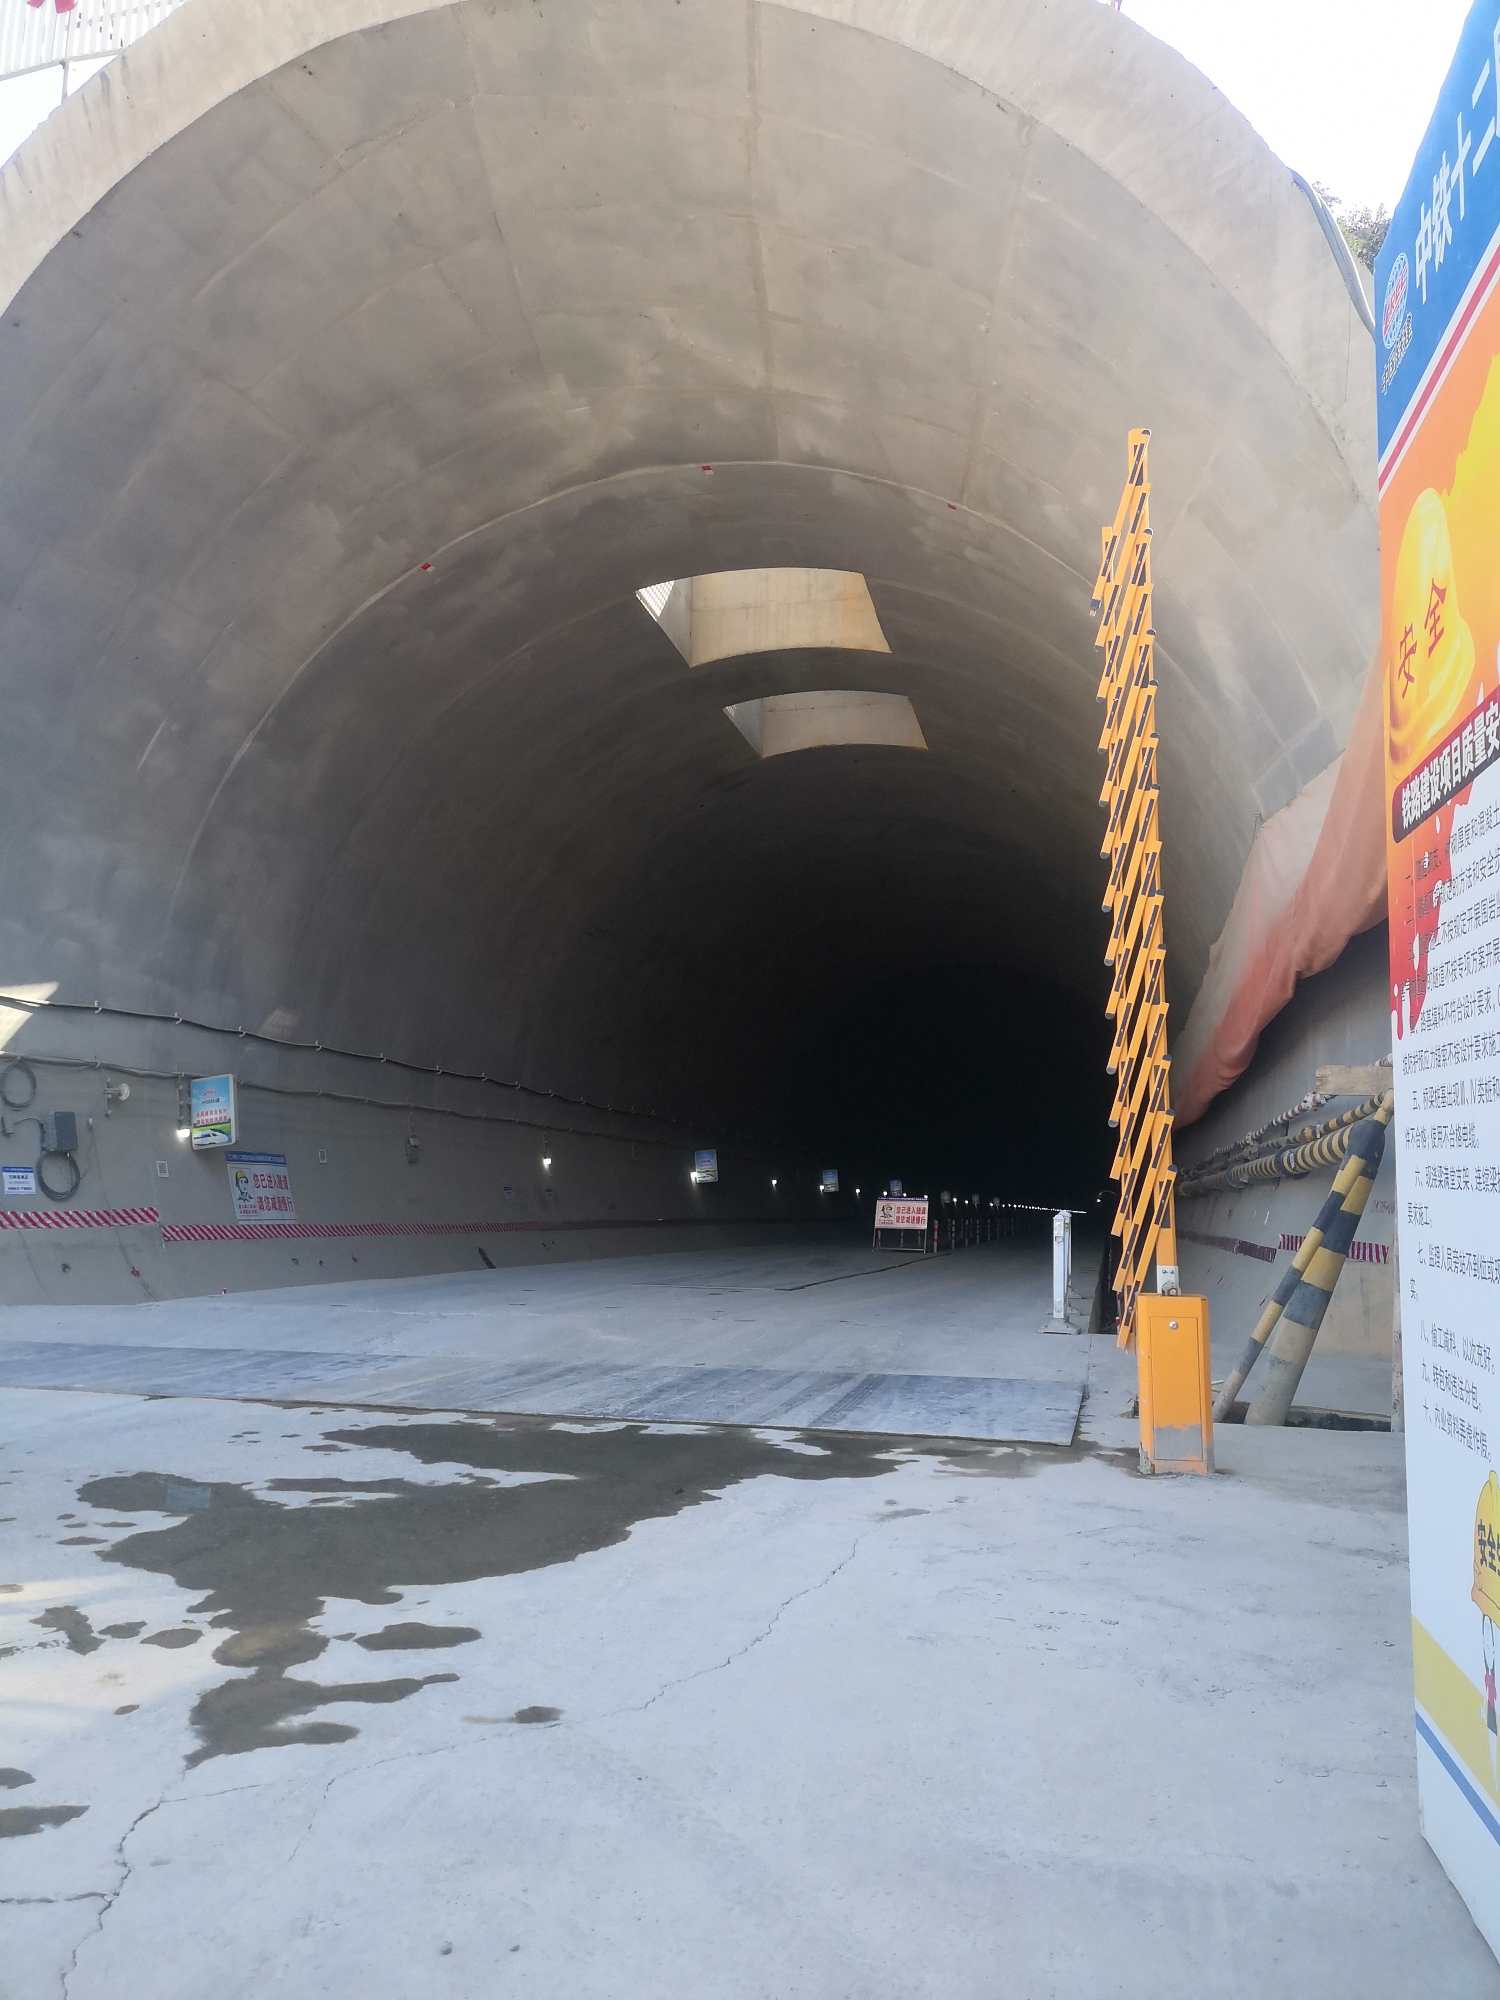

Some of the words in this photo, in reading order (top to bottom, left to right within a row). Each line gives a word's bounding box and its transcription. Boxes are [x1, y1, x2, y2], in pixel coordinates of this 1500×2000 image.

[1398, 577, 1446, 700] 安全
[1401, 701, 1500, 829] 铁路建设项目质量安
